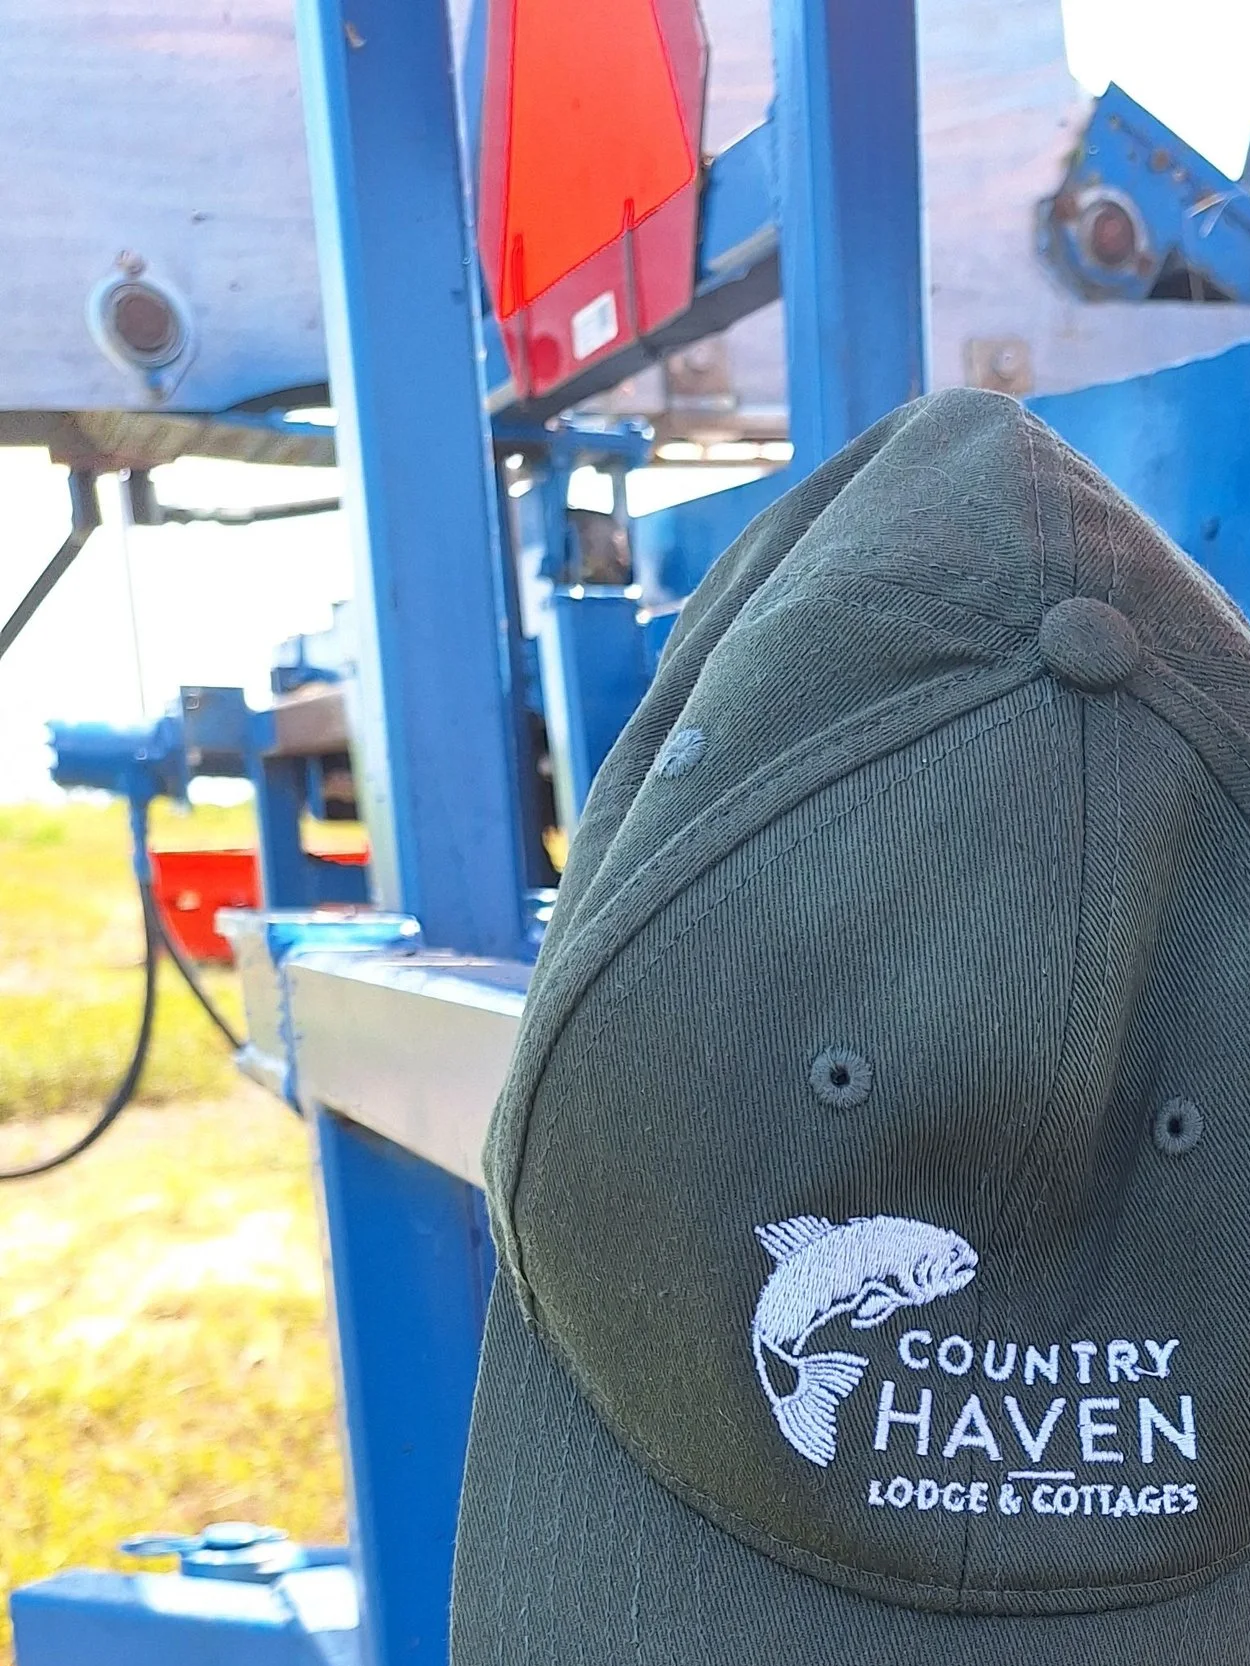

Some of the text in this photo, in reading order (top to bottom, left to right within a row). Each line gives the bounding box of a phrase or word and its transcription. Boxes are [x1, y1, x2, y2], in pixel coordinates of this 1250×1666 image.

[898, 1330, 1180, 1385] COUNTRY
[873, 1381, 1198, 1464] HAVEN
[869, 1476, 1199, 1518] LODGE & COTTAGES
